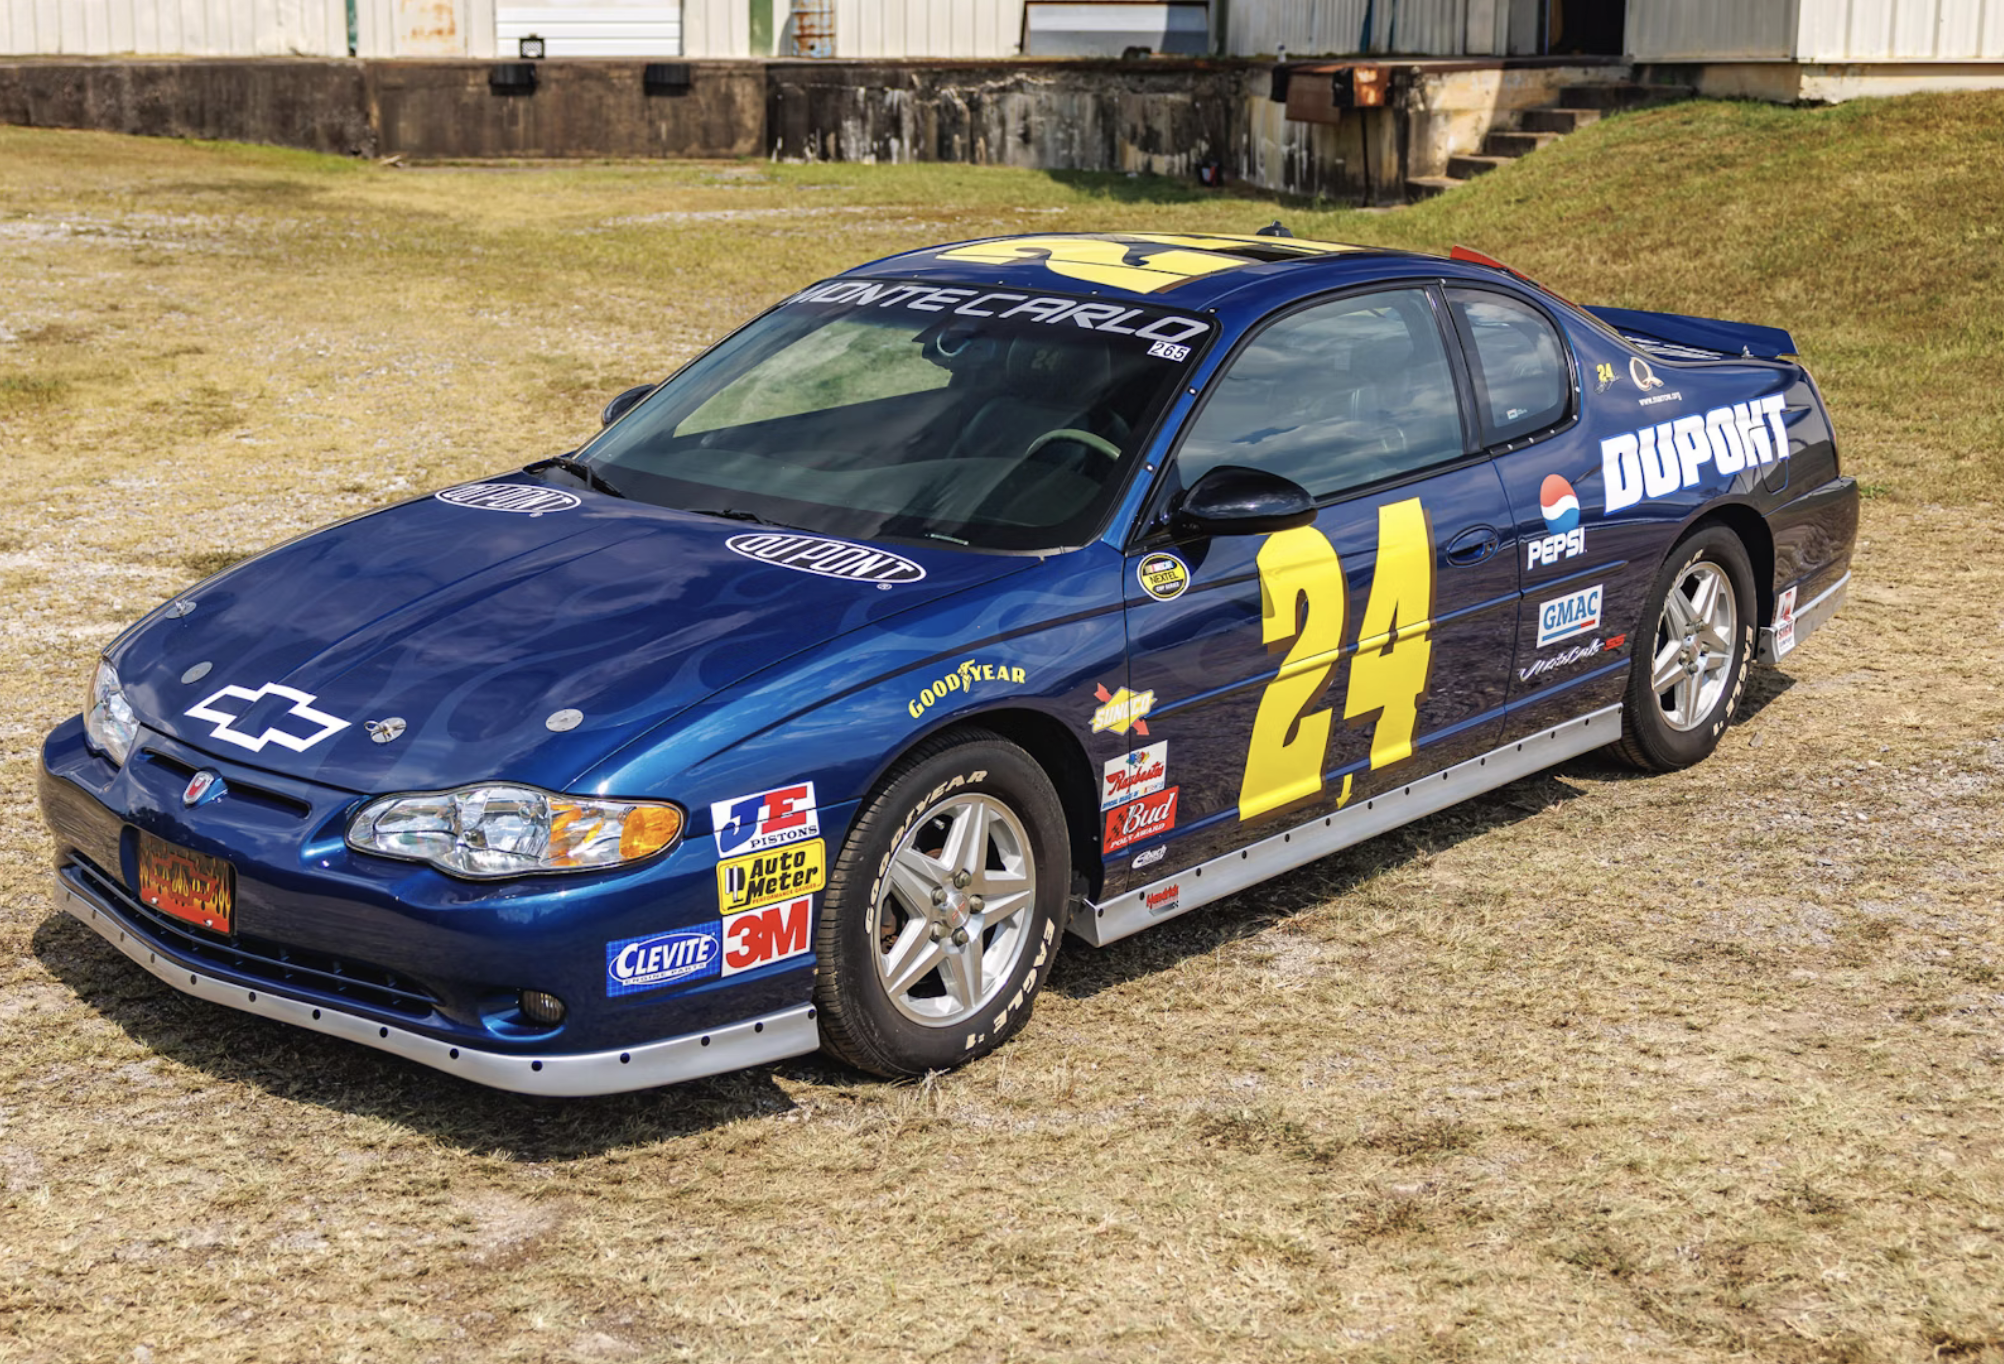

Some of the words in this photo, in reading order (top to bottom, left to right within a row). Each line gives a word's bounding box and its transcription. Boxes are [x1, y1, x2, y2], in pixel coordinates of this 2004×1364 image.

[1150, 342, 1189, 360] 265
[1595, 362, 1615, 382] 24
[1601, 394, 1789, 515] DUPONT
[1527, 526, 1586, 570] PEPSI
[1149, 571, 1180, 584] NEXTEL
[1543, 590, 1598, 631] GMAC
[1238, 496, 1434, 822] 24
[908, 659, 1027, 718] GOODYEAR
[1094, 692, 1151, 730] SUNOCO
[719, 785, 808, 853] JE
[1122, 792, 1176, 836] Bud
[749, 825, 818, 849] PISTONS
[746, 866, 818, 901] Meter
[750, 851, 806, 879] Auto
[752, 890, 794, 904] PERFORMANCE
[725, 898, 810, 969] 3M
[616, 935, 713, 979] CLEVITE
[992, 917, 1055, 1036] EAGLE
